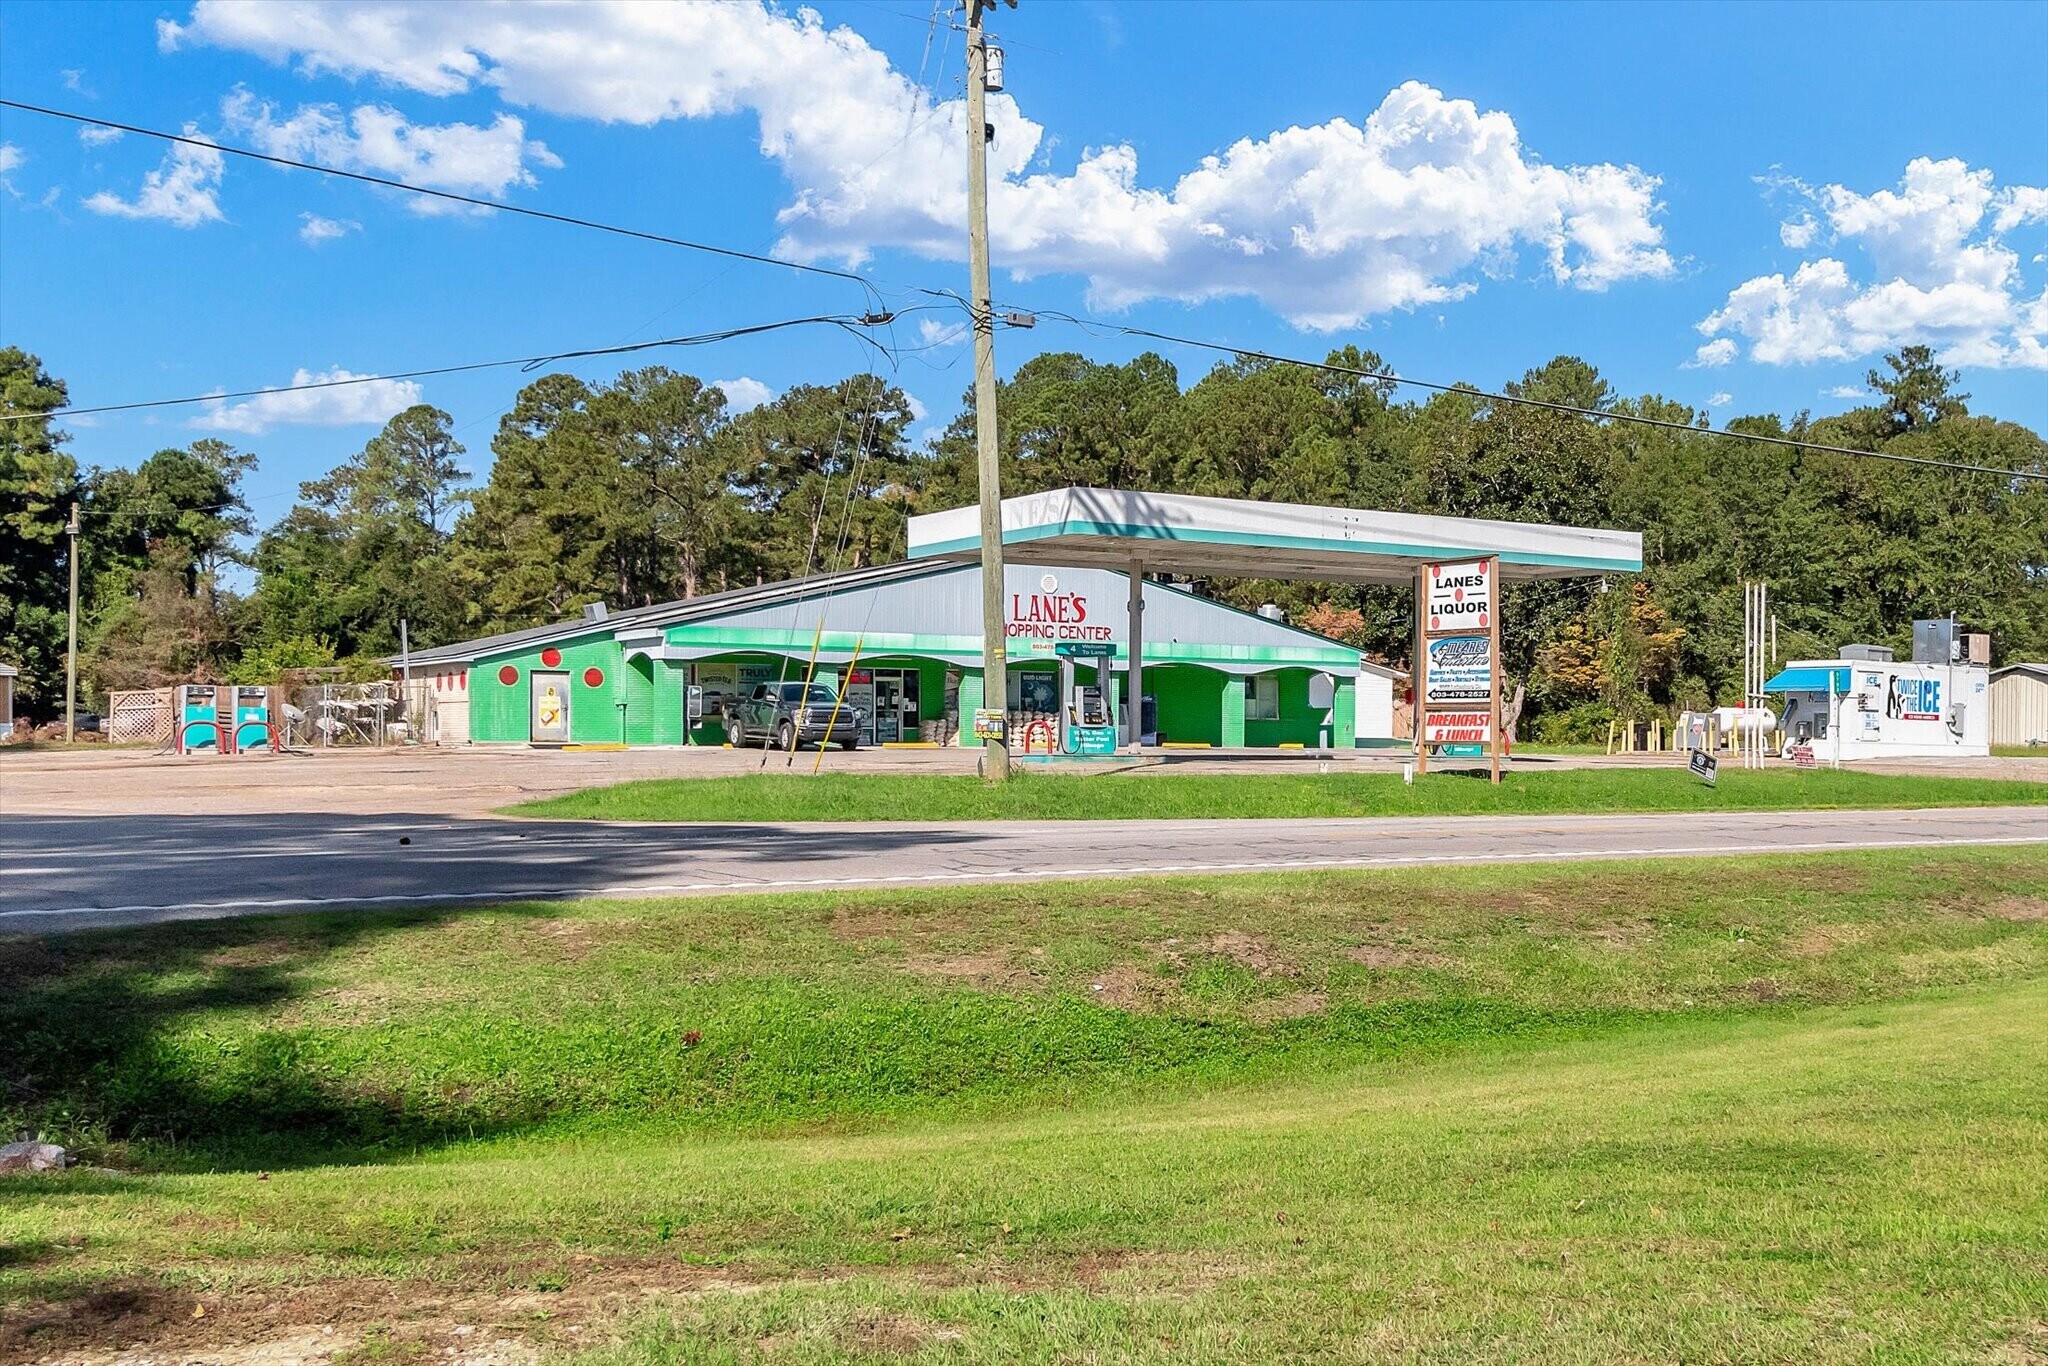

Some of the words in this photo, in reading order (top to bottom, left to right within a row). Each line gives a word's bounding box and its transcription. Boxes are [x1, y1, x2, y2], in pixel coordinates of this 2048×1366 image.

[1436, 575, 1484, 589] LANES
[1013, 592, 1087, 623] LANE'S
[1431, 601, 1488, 616] LIQUOR
[1059, 625, 1112, 641] CENTER
[739, 668, 774, 678] TRULY
[1866, 676, 1878, 684] ICE
[1897, 678, 1918, 696] TWICE
[1918, 679, 1940, 713] ICE
[1906, 696, 1918, 712] THE
[1427, 714, 1490, 726] BREAKFAST
[1435, 729, 1443, 742] &
[1446, 729, 1484, 741] LUNCH
